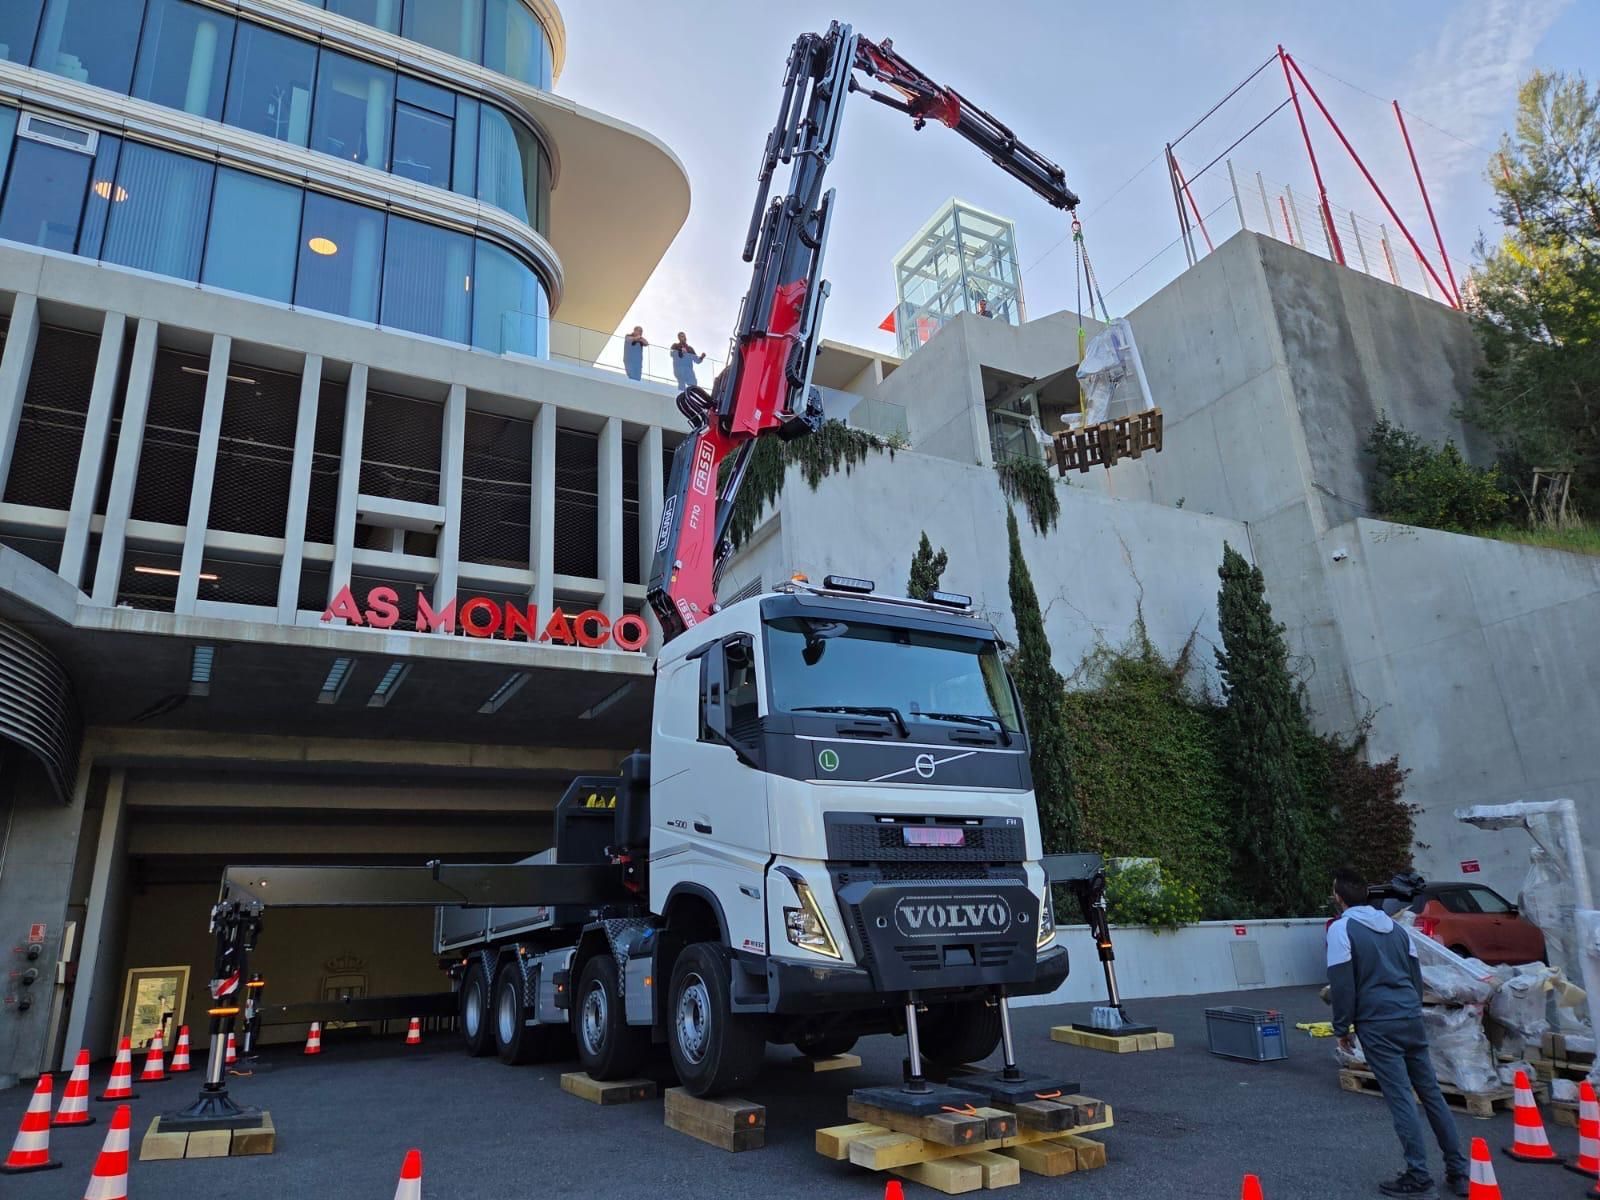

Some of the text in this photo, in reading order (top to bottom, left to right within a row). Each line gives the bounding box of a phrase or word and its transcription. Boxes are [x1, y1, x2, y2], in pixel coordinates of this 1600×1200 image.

[695, 444, 713, 491] FASSI
[690, 504, 701, 529] F710
[321, 584, 649, 650] AS MONACO
[678, 600, 696, 628] ASSI
[825, 753, 835, 767] L
[899, 904, 1006, 928] VOLVO
